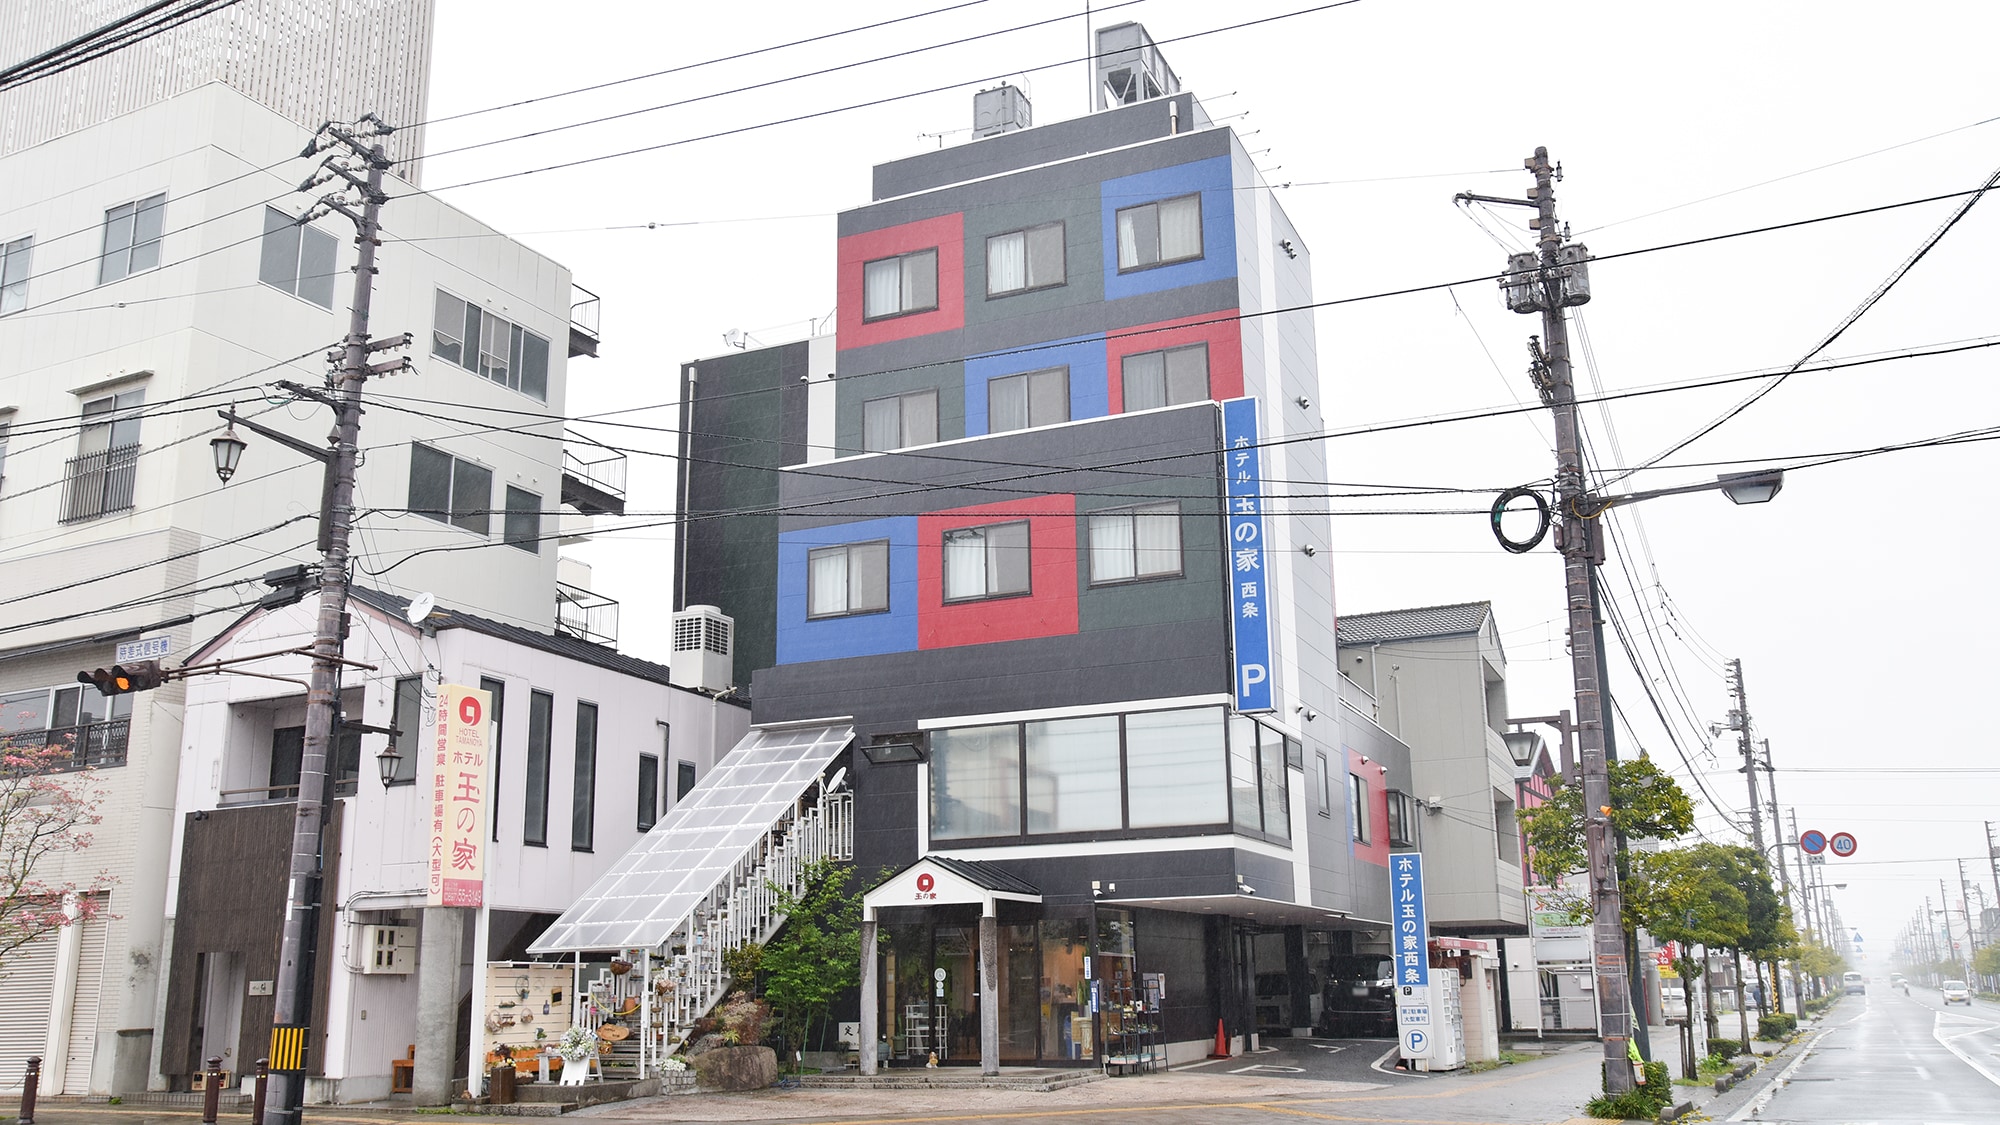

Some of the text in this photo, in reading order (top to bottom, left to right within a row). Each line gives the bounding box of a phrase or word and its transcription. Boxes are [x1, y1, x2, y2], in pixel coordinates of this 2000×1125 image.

[1234, 435, 1261, 619] ホテル 玉の家 西条
[1241, 663, 1266, 697] P
[436, 694, 448, 767] 24時間営業
[458, 727, 480, 739] HOTEL
[453, 750, 483, 767] ホテル
[451, 771, 480, 871] 玉の家
[1836, 838, 1852, 850] 40
[914, 892, 937, 901] 玉の家
[1398, 857, 1421, 984] ホテル玉の家西条
[1410, 1033, 1424, 1050] P
